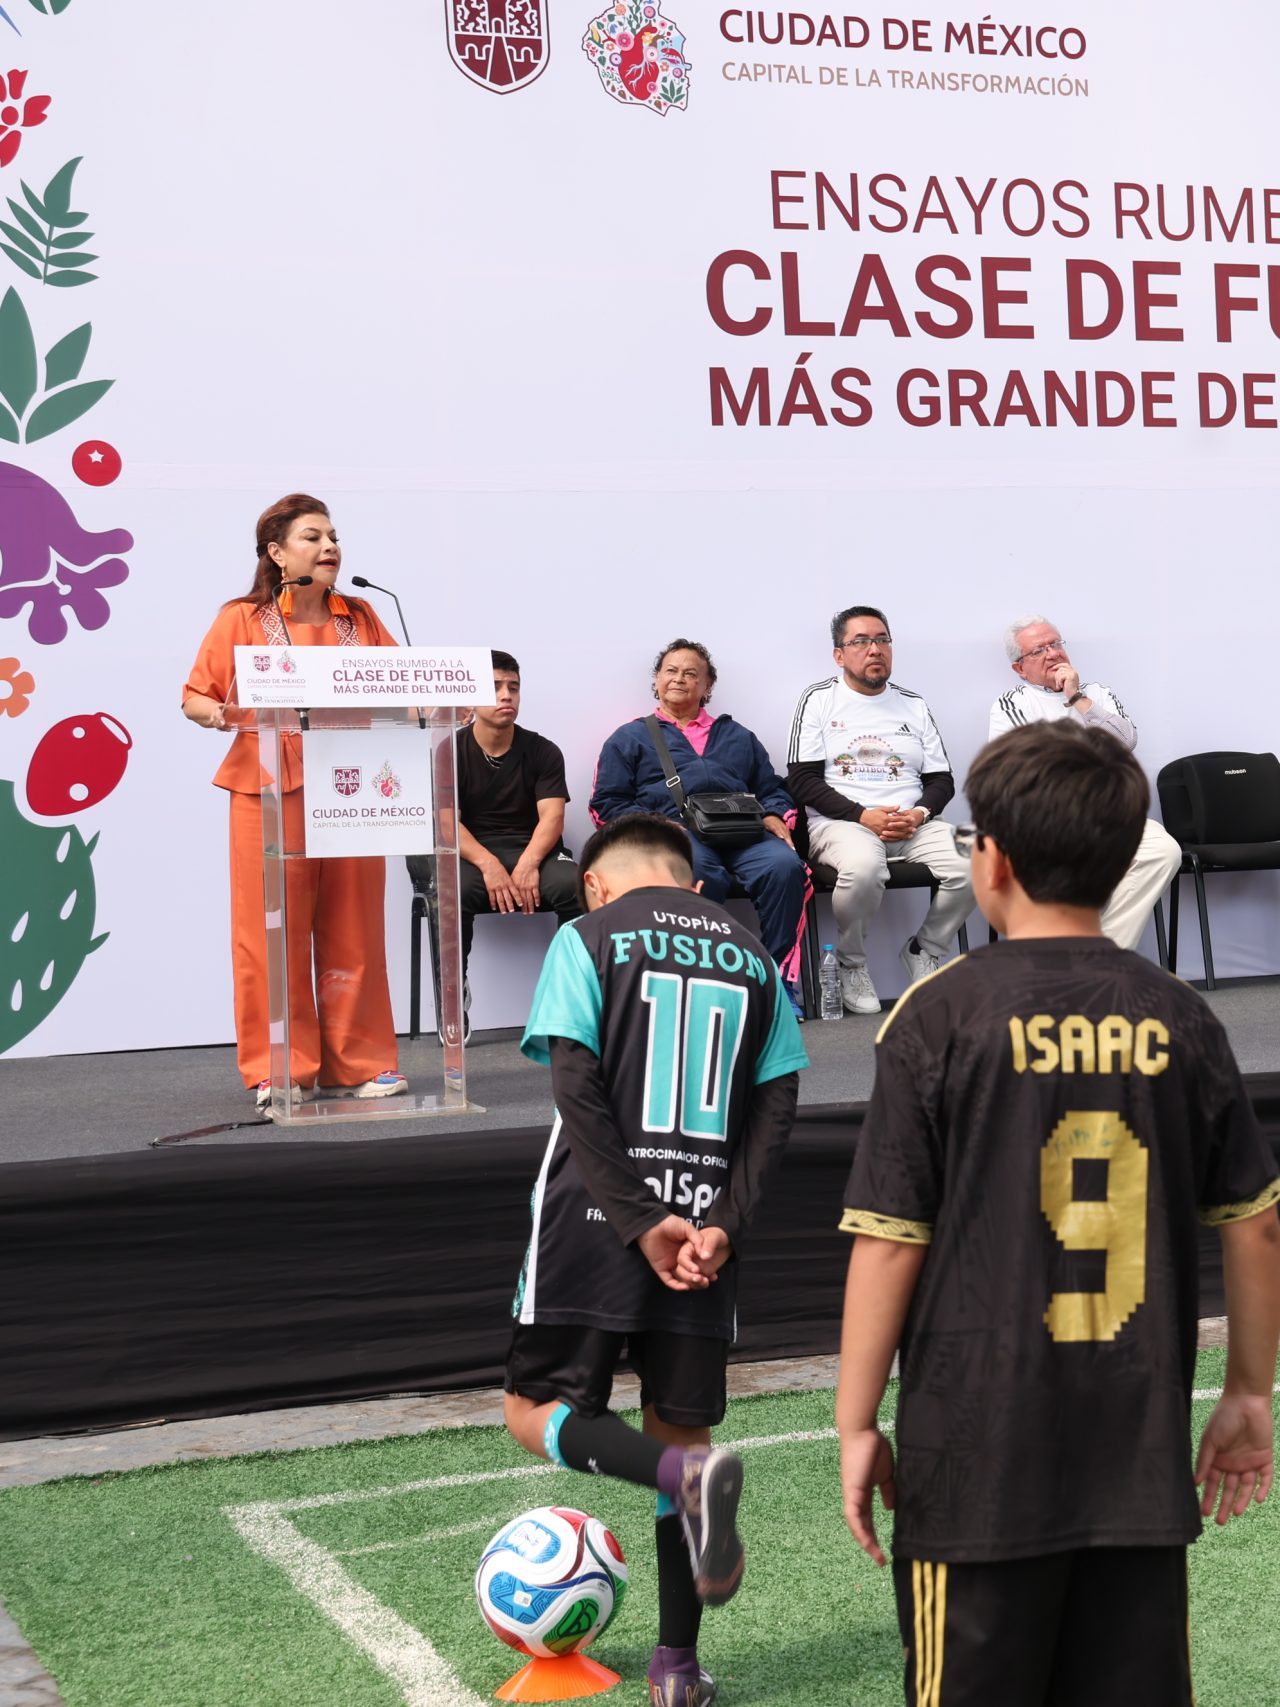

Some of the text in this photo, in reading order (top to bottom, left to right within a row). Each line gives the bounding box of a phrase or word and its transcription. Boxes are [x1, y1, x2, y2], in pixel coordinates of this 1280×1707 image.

[719, 8, 1087, 60] CIUDAD DE MÉXICO
[721, 61, 1089, 97] CAPITAL DE LA TRANSFORMACIÓN
[770, 169, 1091, 239] ENSAYOS
[705, 249, 1035, 340] CLASE
[1065, 258, 1185, 342] DE
[708, 351, 873, 428] MÁS
[896, 367, 1178, 428] GRANDE
[332, 670, 476, 682] CLASE DE FUTBOL
[333, 683, 477, 694] MÁS GRANDE DEL MUNDO
[342, 659, 464, 669] ENSAYOS RUMBO A LA
[312, 805, 426, 819] CIUDAD DE MÉXICO
[312, 821, 340, 829] CAPITAL
[353, 820, 361, 828] LA
[363, 818, 427, 828] TRANSFORMACIÓN
[610, 928, 768, 987] FUSION
[640, 970, 750, 1143] 10
[1009, 1014, 1171, 1076] ISAAC
[626, 1147, 699, 1165] ATROCINAOR
[1039, 1110, 1149, 1343] 9
